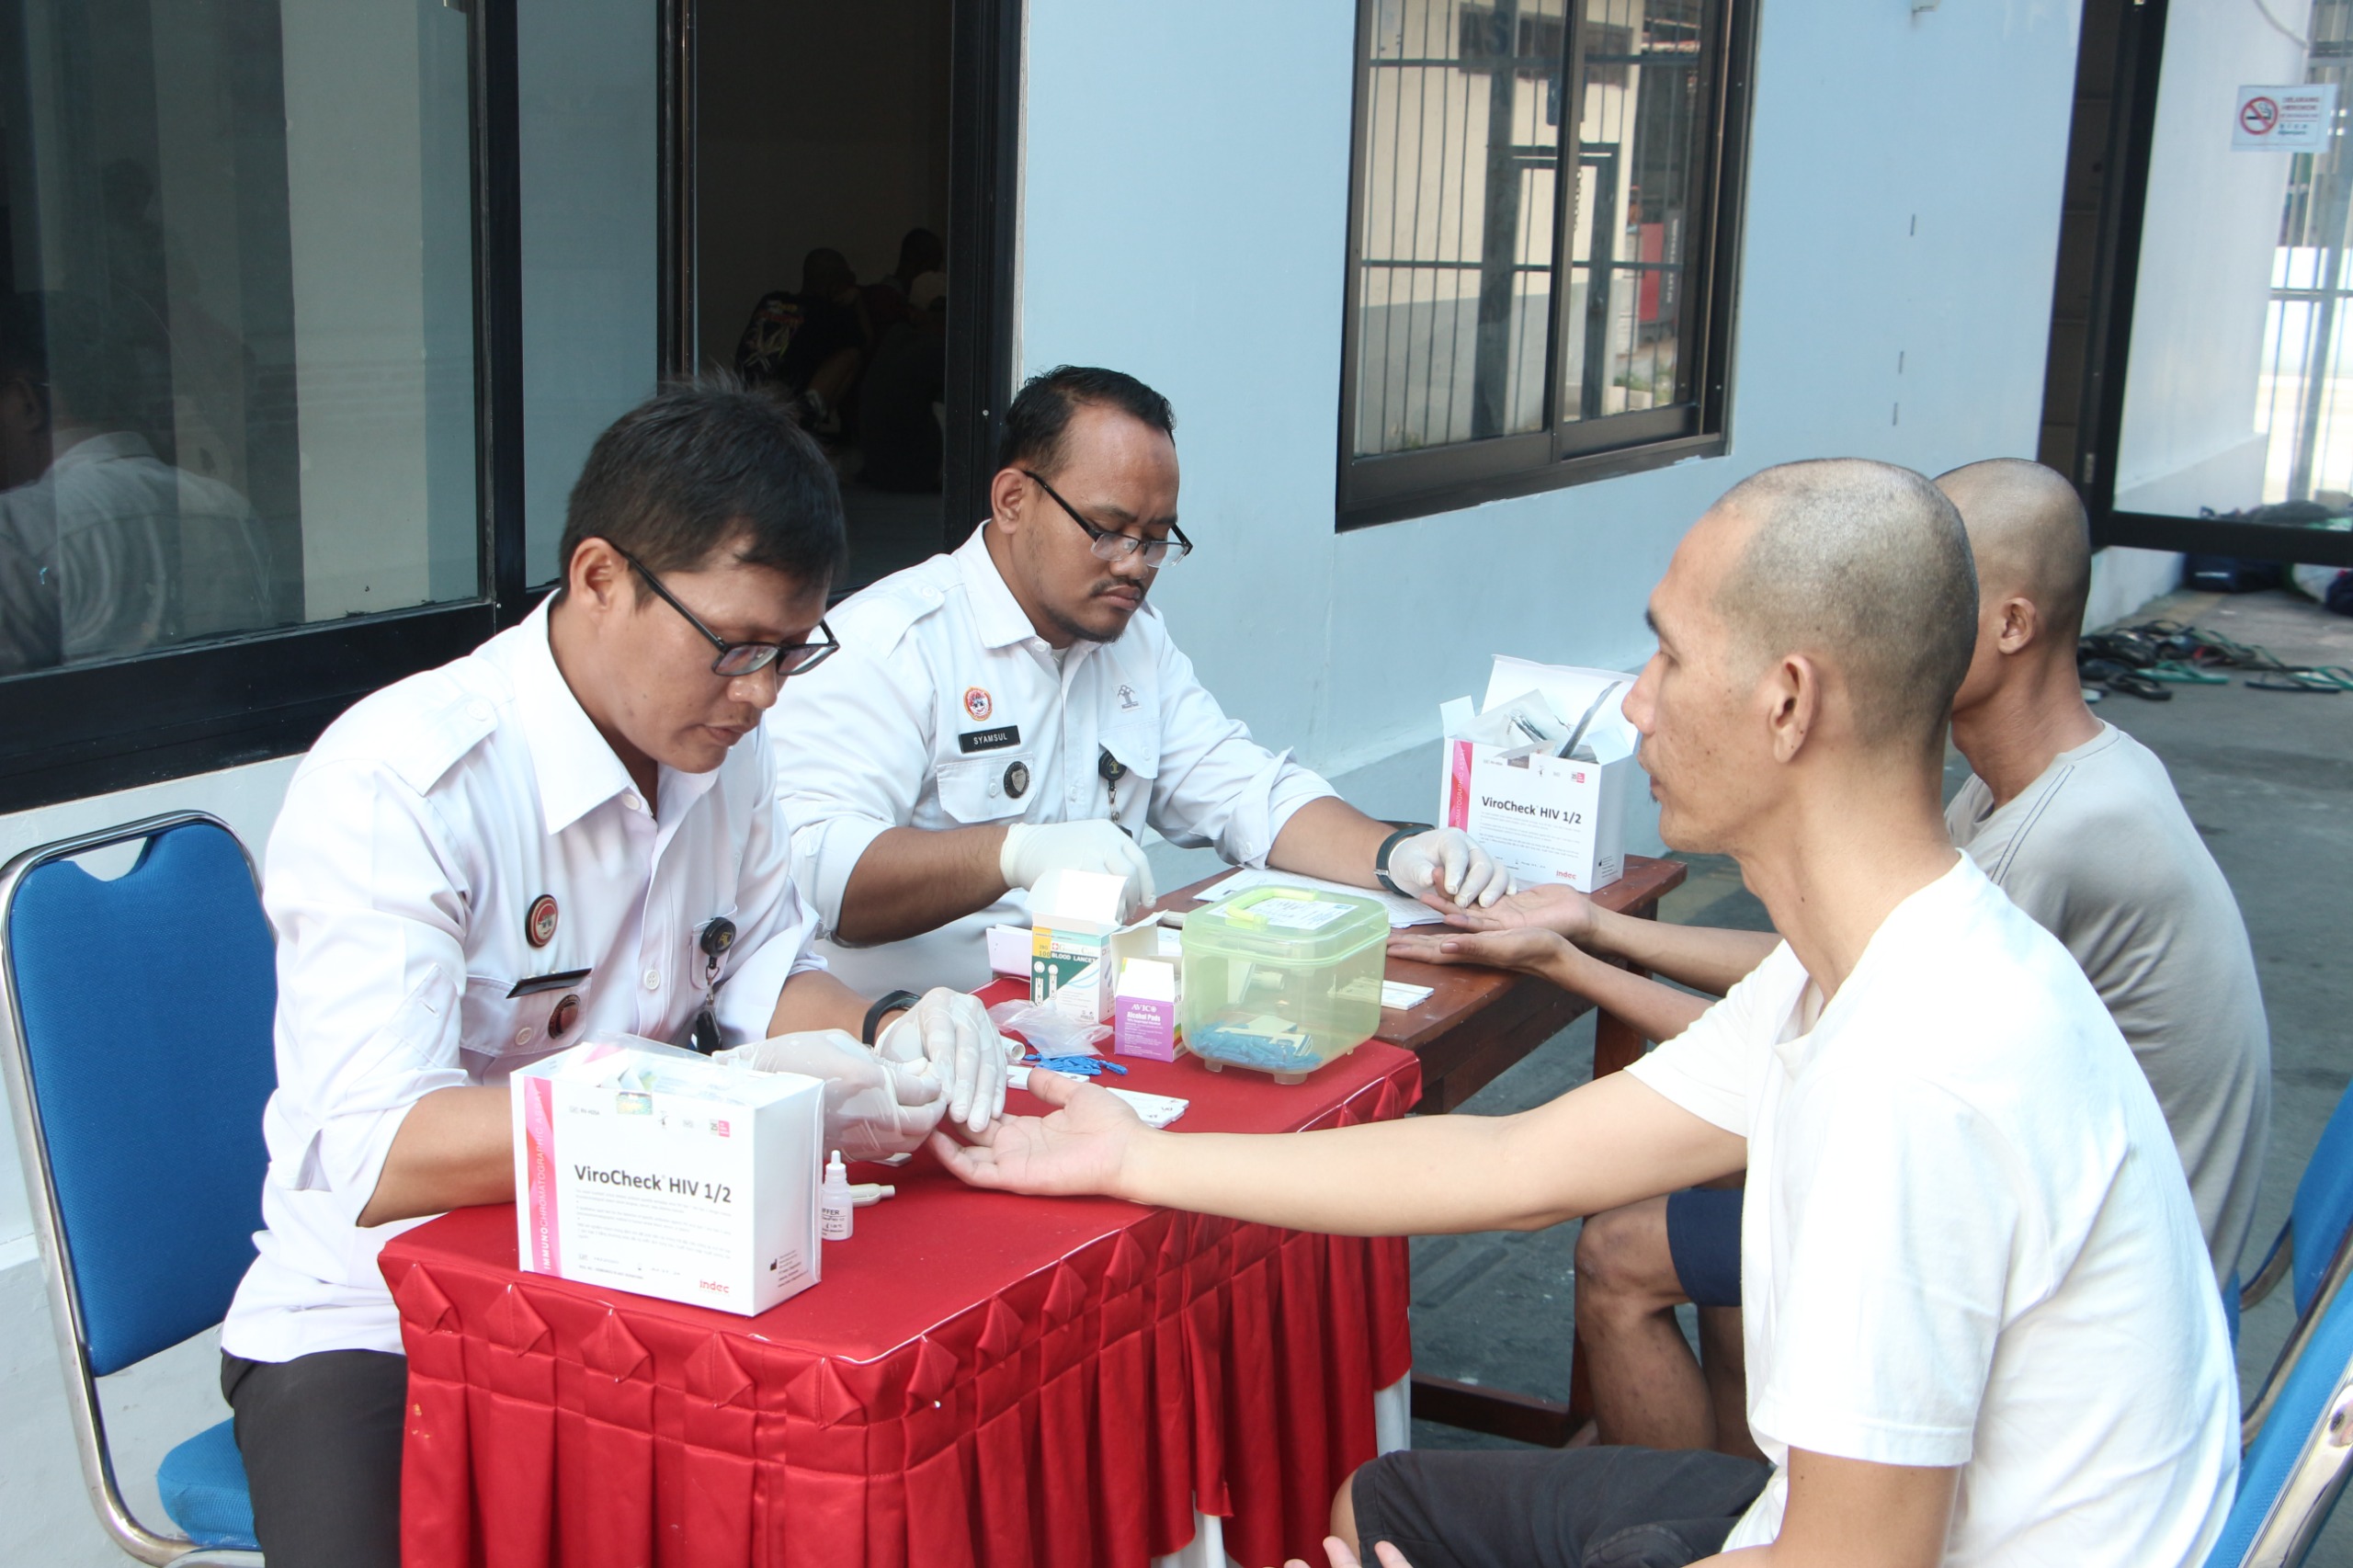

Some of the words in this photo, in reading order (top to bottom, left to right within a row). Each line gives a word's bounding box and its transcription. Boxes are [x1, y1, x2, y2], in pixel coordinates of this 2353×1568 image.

[972, 732, 1008, 746] SYAMSUL
[1482, 796, 1536, 815] ViroCheck
[1540, 807, 1560, 820] HIV
[1563, 812, 1582, 824] 1/2
[1051, 952, 1072, 960] BLOOD
[1131, 1004, 1157, 1013] AVICO
[1127, 1011, 1147, 1019] Alcohol
[1147, 1014, 1161, 1022] Pads
[535, 1089, 543, 1125] ASSAY
[574, 1165, 662, 1191] ViroCheck
[669, 1177, 699, 1197] HIV
[704, 1183, 732, 1204] 1/2
[536, 1127, 551, 1270] IMMUNOCHROMATOGRAPHIC
[822, 1208, 840, 1216] FFER
[699, 1279, 730, 1294] indec
